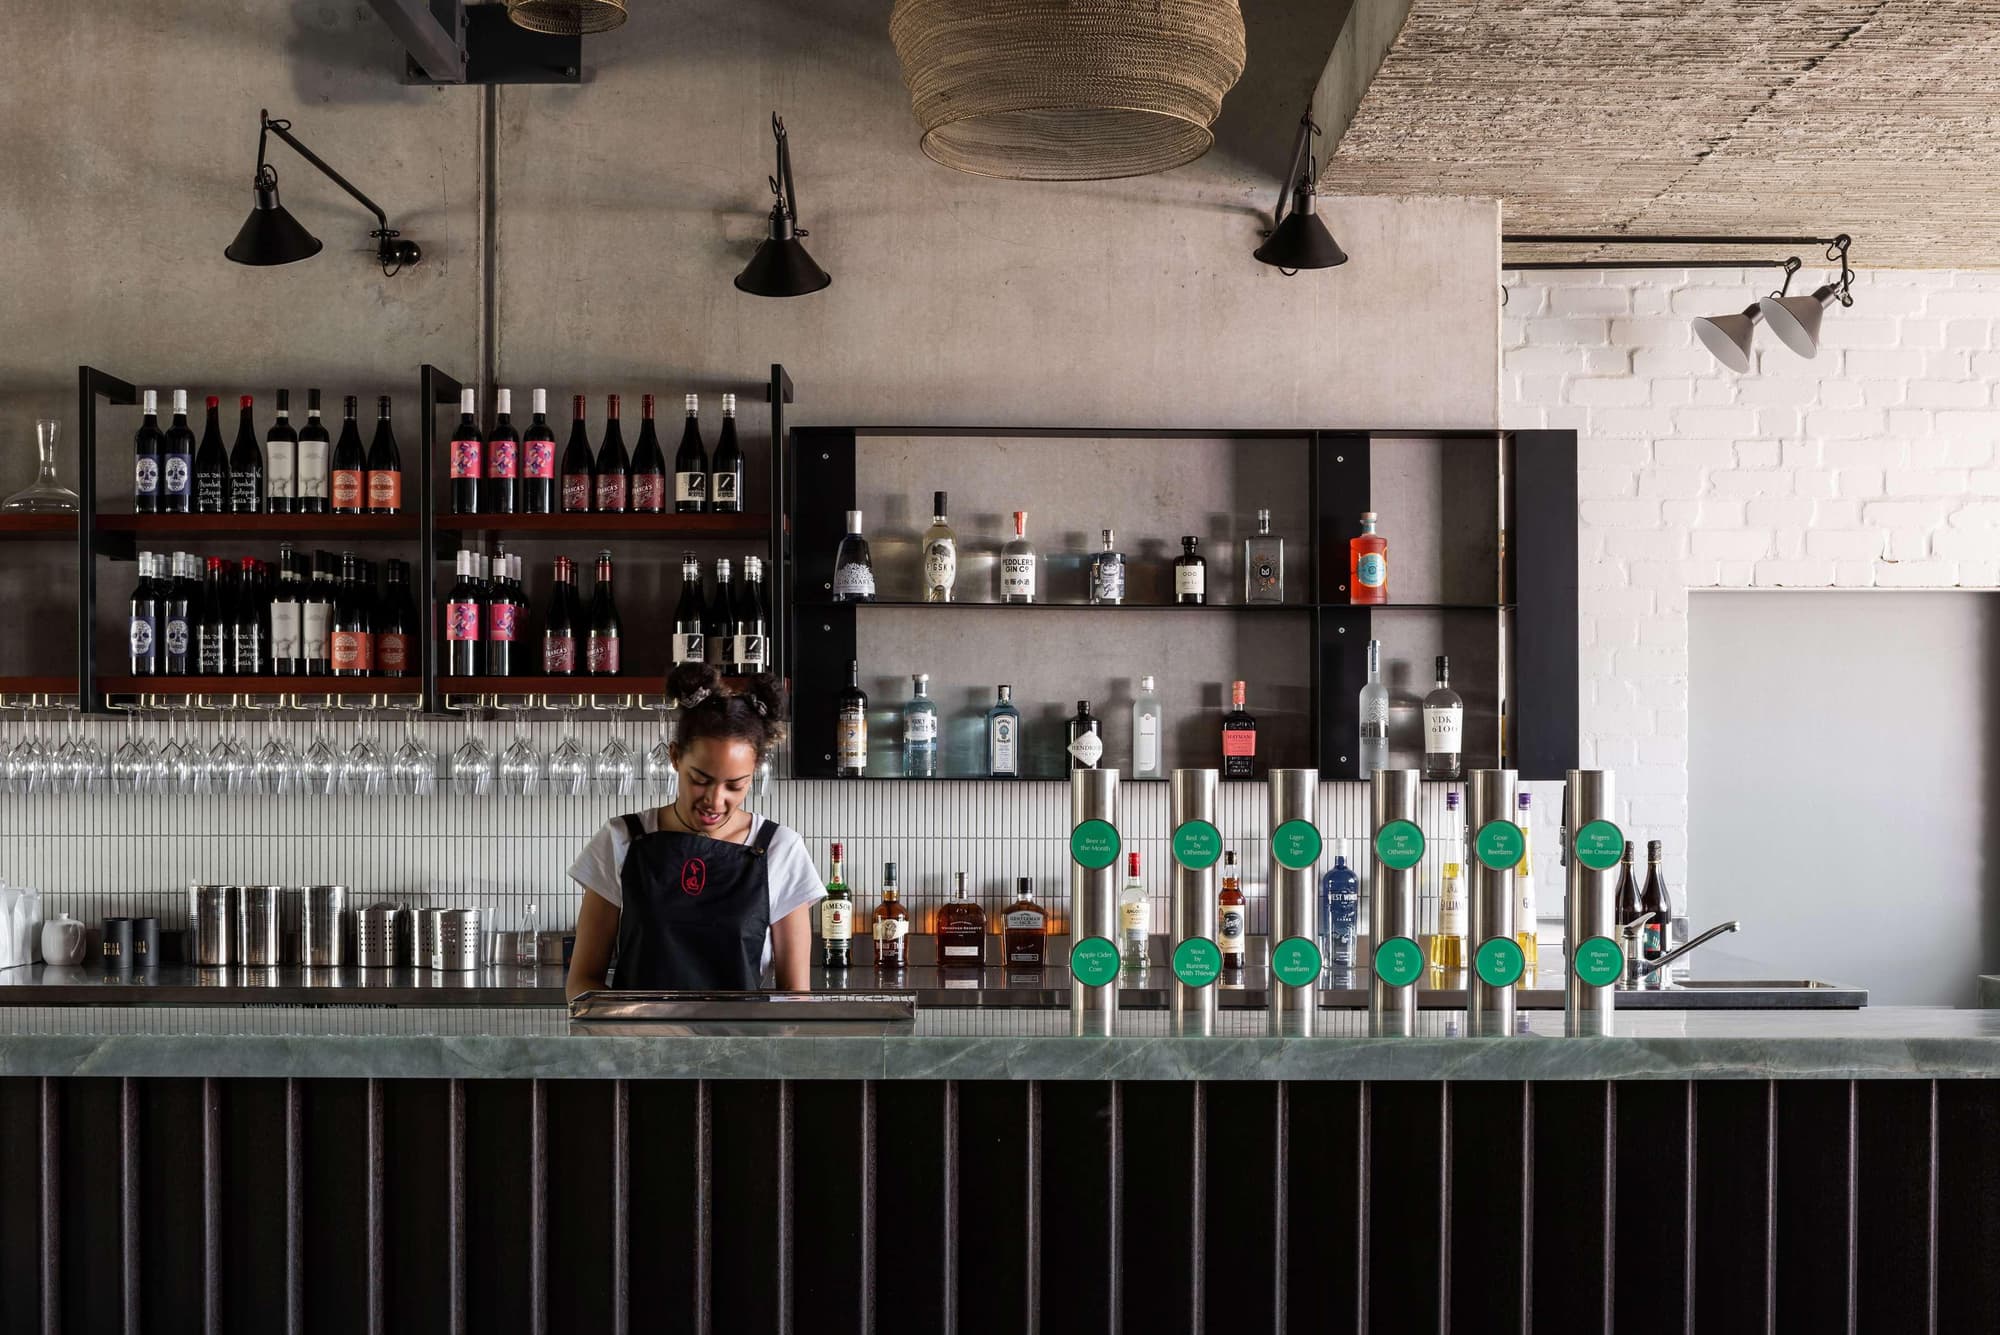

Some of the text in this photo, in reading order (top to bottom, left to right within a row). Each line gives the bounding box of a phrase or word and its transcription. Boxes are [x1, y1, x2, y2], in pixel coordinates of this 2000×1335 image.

[1002, 558, 1033, 566] PEDDLERS
[1289, 834, 1305, 842] Lager
[1590, 834, 1609, 842] Rogers
[1594, 848, 1621, 856] Creatures
[1078, 951, 1096, 959] Apple
